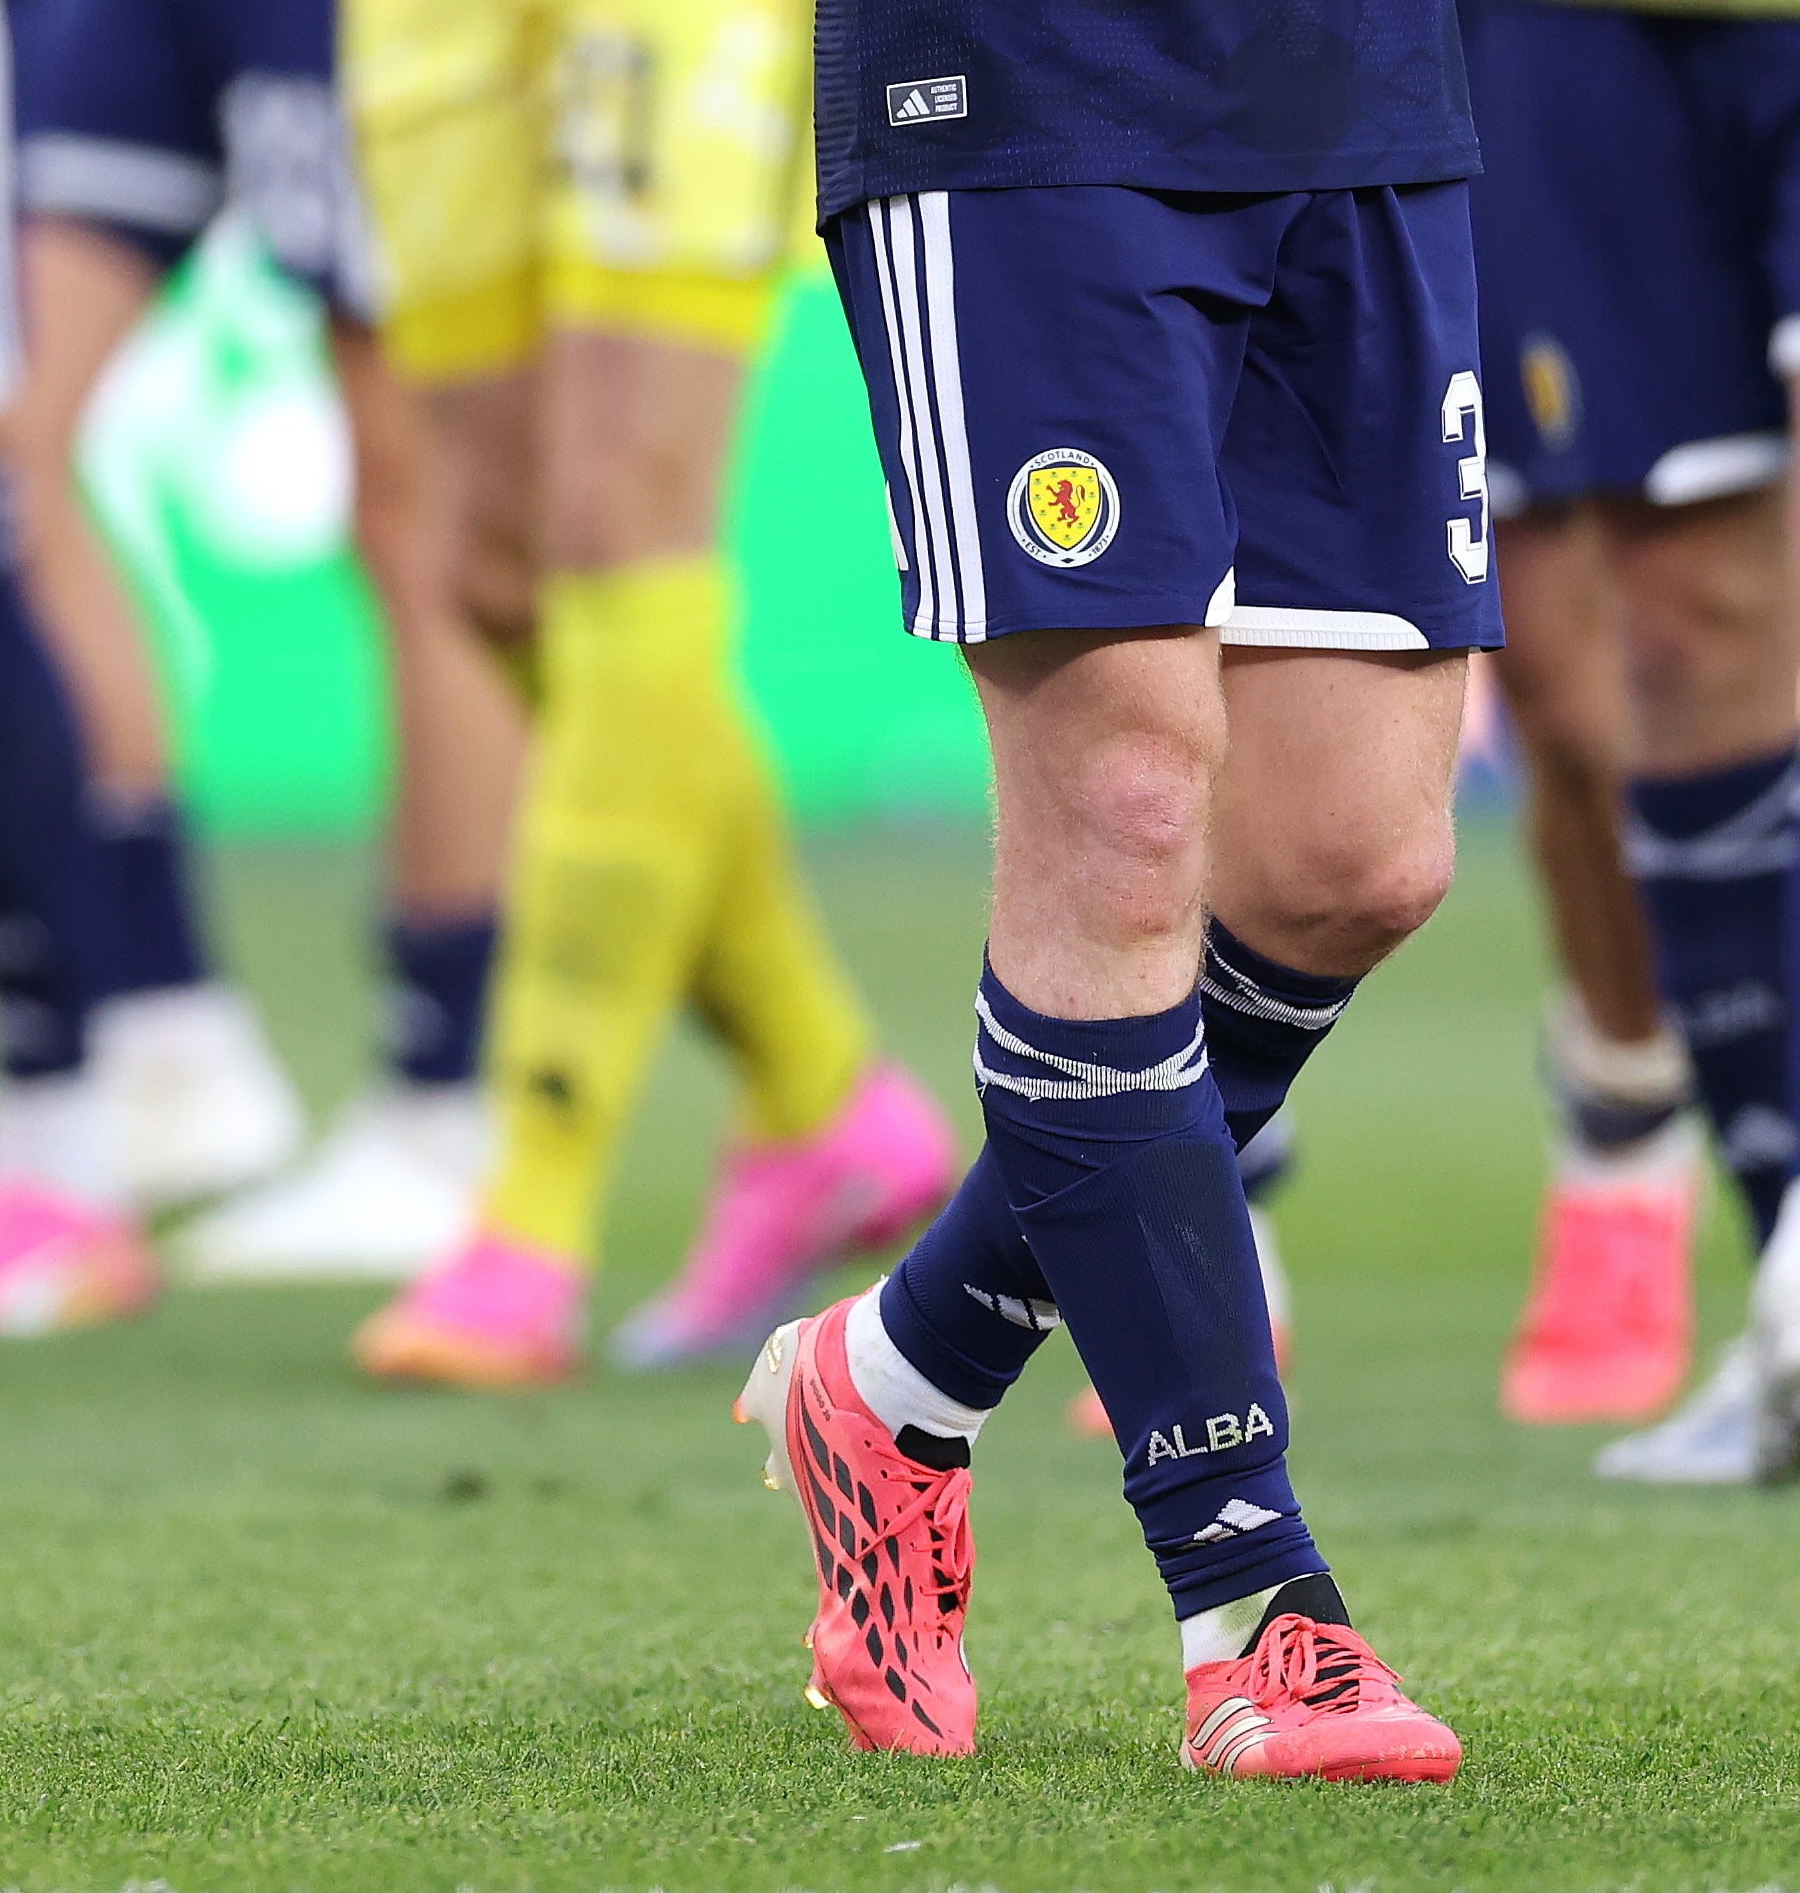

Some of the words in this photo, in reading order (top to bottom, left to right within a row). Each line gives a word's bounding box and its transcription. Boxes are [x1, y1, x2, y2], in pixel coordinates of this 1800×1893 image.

[1034, 450, 1090, 467] SCOTLAND
[1441, 370, 1489, 585] 3
[1025, 541, 1041, 556] EST
[1092, 537, 1108, 555] 1873
[1148, 1402, 1274, 1467] ALBA
